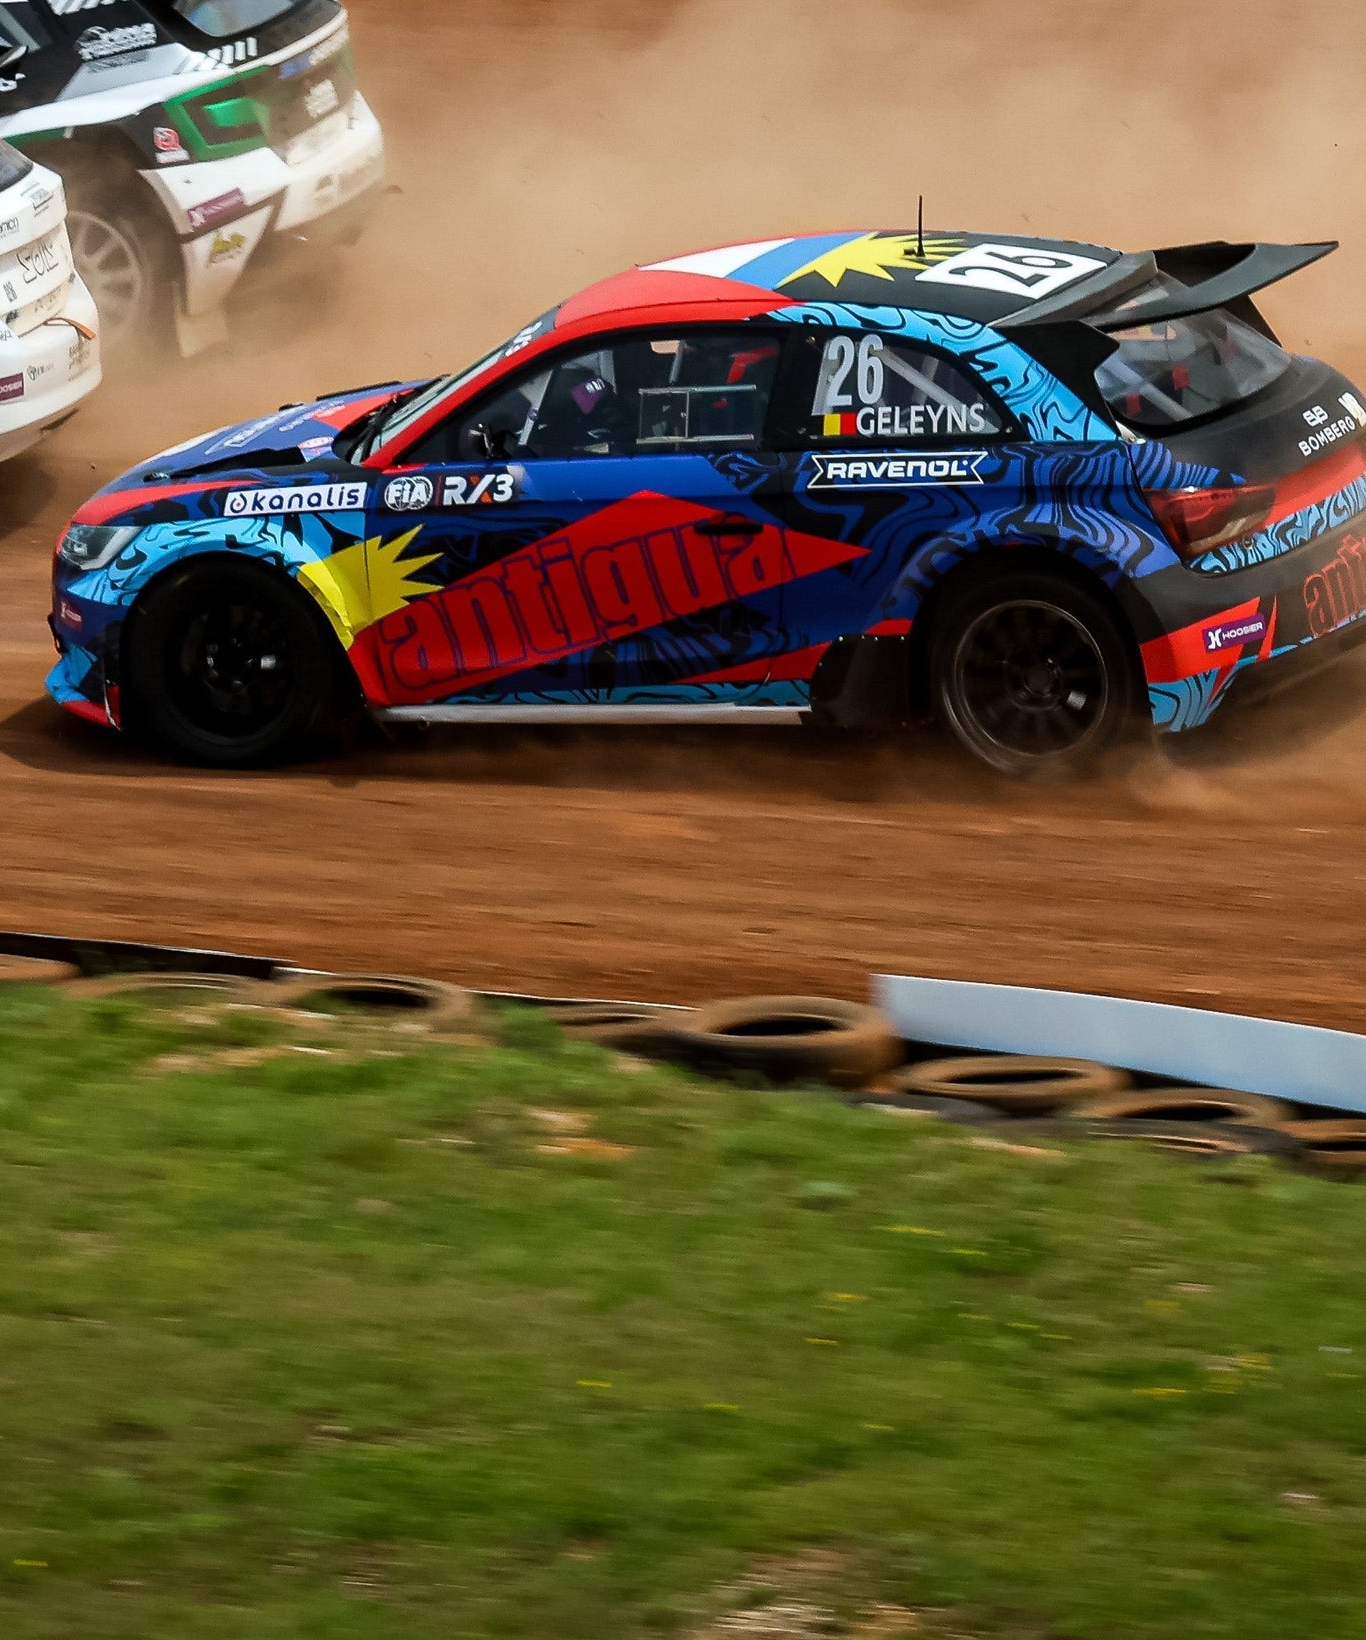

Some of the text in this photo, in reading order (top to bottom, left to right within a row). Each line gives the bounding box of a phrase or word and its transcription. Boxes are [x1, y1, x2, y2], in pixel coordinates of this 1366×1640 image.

[824, 333, 884, 407] 26
[855, 402, 985, 437] GELEYNS
[826, 460, 968, 480] RAVENOL
[251, 485, 361, 512] kanalis
[386, 473, 515, 507] FIA RX3
[379, 520, 798, 691] antigua
